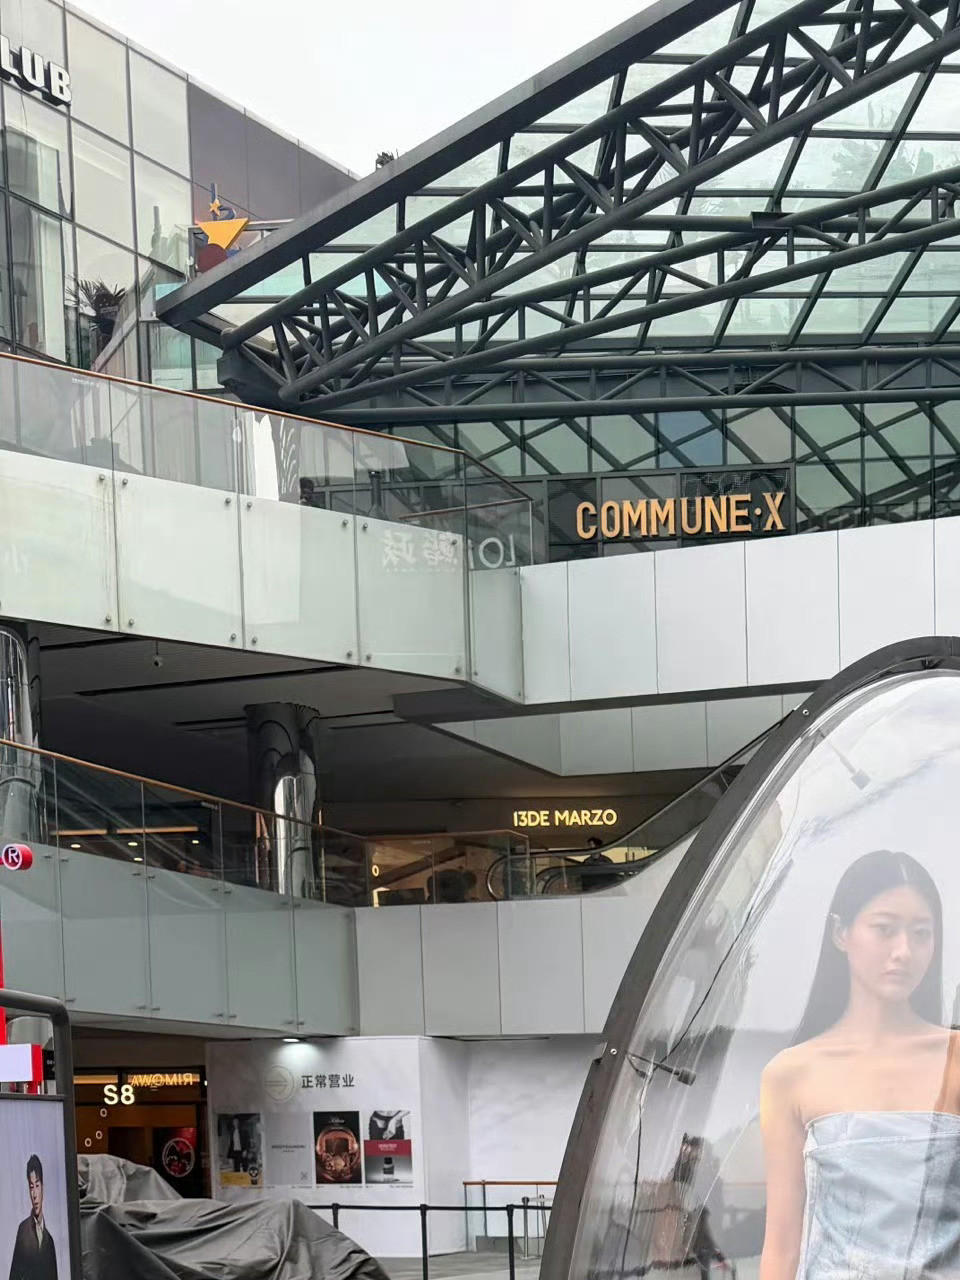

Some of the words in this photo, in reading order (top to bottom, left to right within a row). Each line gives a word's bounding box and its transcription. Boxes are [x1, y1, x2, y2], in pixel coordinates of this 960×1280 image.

[554, 808, 618, 826] MARZO
[301, 1073, 355, 1089] 正常营业
[103, 1084, 136, 1106] S8
